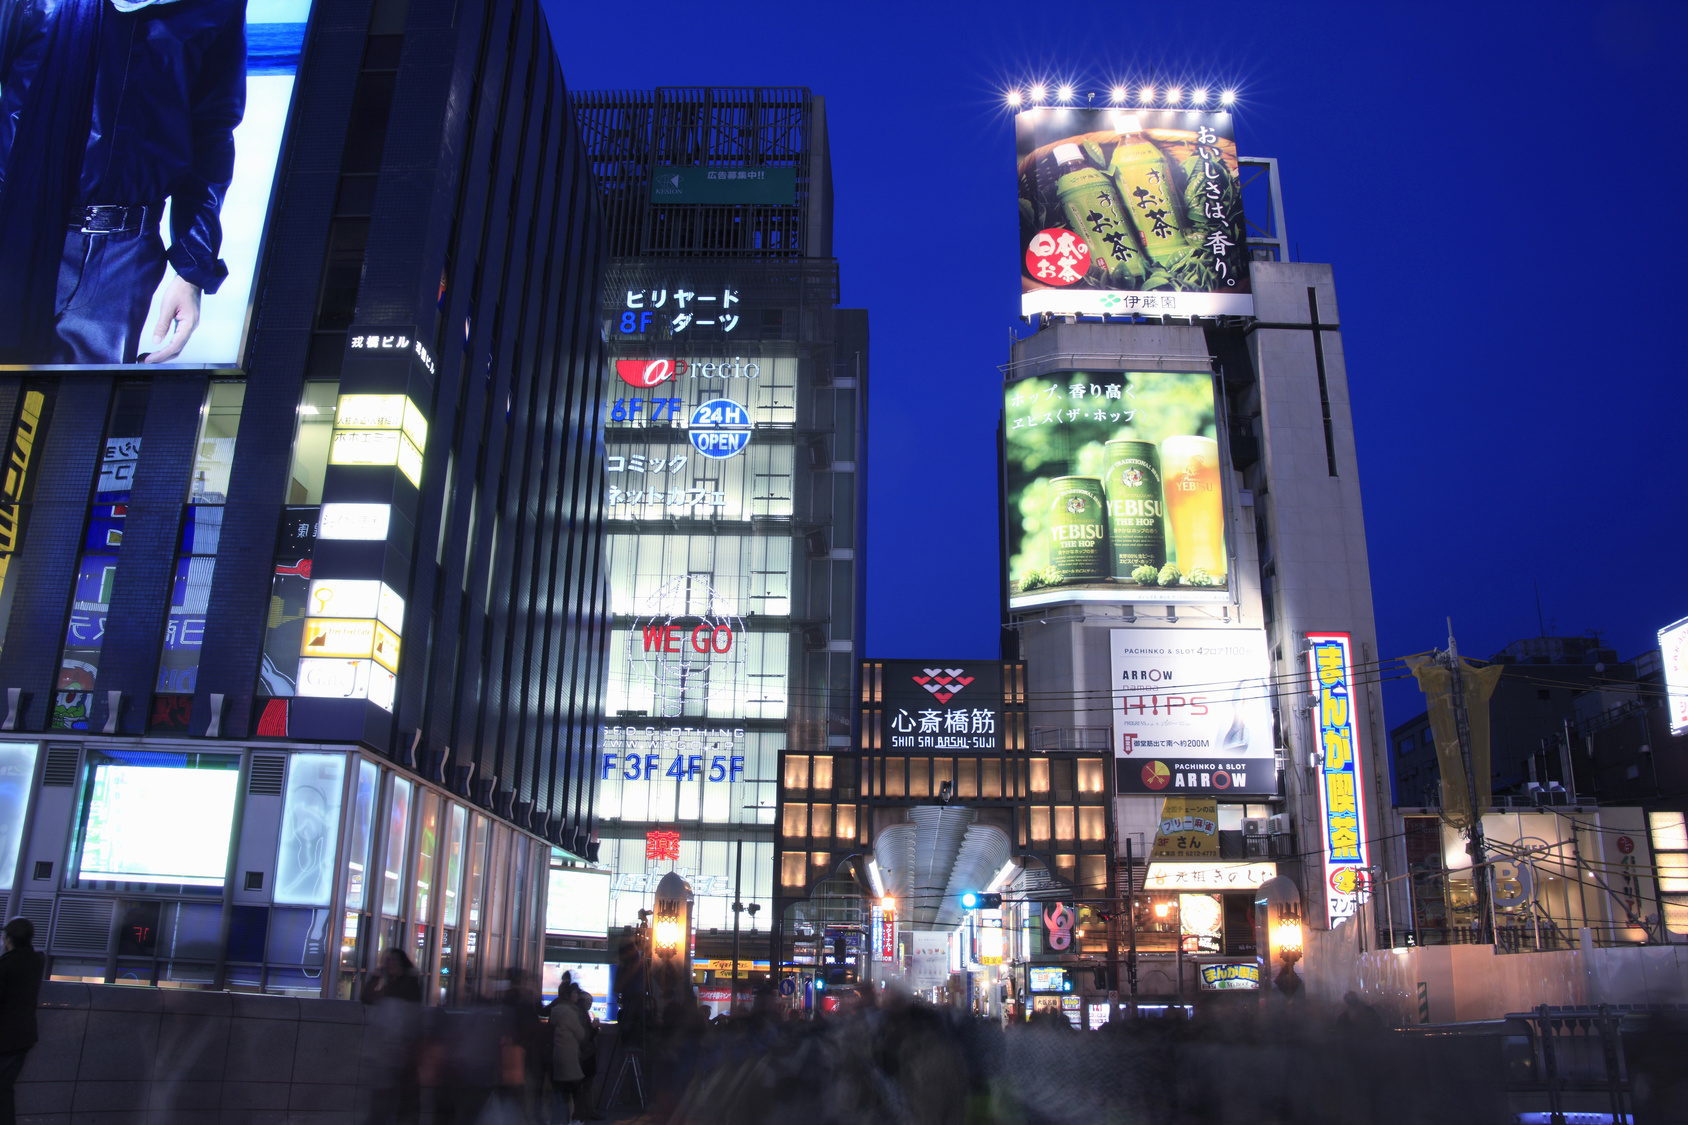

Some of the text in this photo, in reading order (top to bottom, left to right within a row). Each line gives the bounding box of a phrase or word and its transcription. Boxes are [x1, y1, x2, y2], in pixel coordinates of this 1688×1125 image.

[1198, 125, 1236, 287] おいしさは、香り。
[626, 288, 739, 309] ビリヤード
[1123, 296, 1176, 309] 伊藤園
[619, 311, 653, 334] 8F
[672, 312, 739, 333] ダーツ
[351, 336, 410, 348] 戎橋ビル
[611, 398, 681, 421] 6F 7F
[699, 407, 740, 424] 24H
[698, 433, 739, 451] OPEN
[608, 454, 688, 474] コミック
[1106, 499, 1164, 518] YEBISU
[1116, 518, 1155, 526] THE HOP
[1050, 524, 1104, 541] YEBISU
[1060, 540, 1077, 548] THE
[1078, 540, 1096, 548] HOP
[1123, 669, 1173, 682] ARROW
[891, 708, 996, 734] 心斎橋筋
[892, 736, 915, 748] SHIN
[1317, 645, 1358, 858] まんが喫茶
[623, 753, 660, 781] 3F
[665, 754, 703, 782] 4F
[708, 755, 745, 783] 5F
[1174, 770, 1247, 790] ARROW
[1163, 817, 1214, 832] フリー麻雀
[646, 830, 680, 861] 薬
[1157, 838, 1170, 847] 3F
[1177, 835, 1202, 849] さん
[885, 923, 893, 952] マクドナルド
